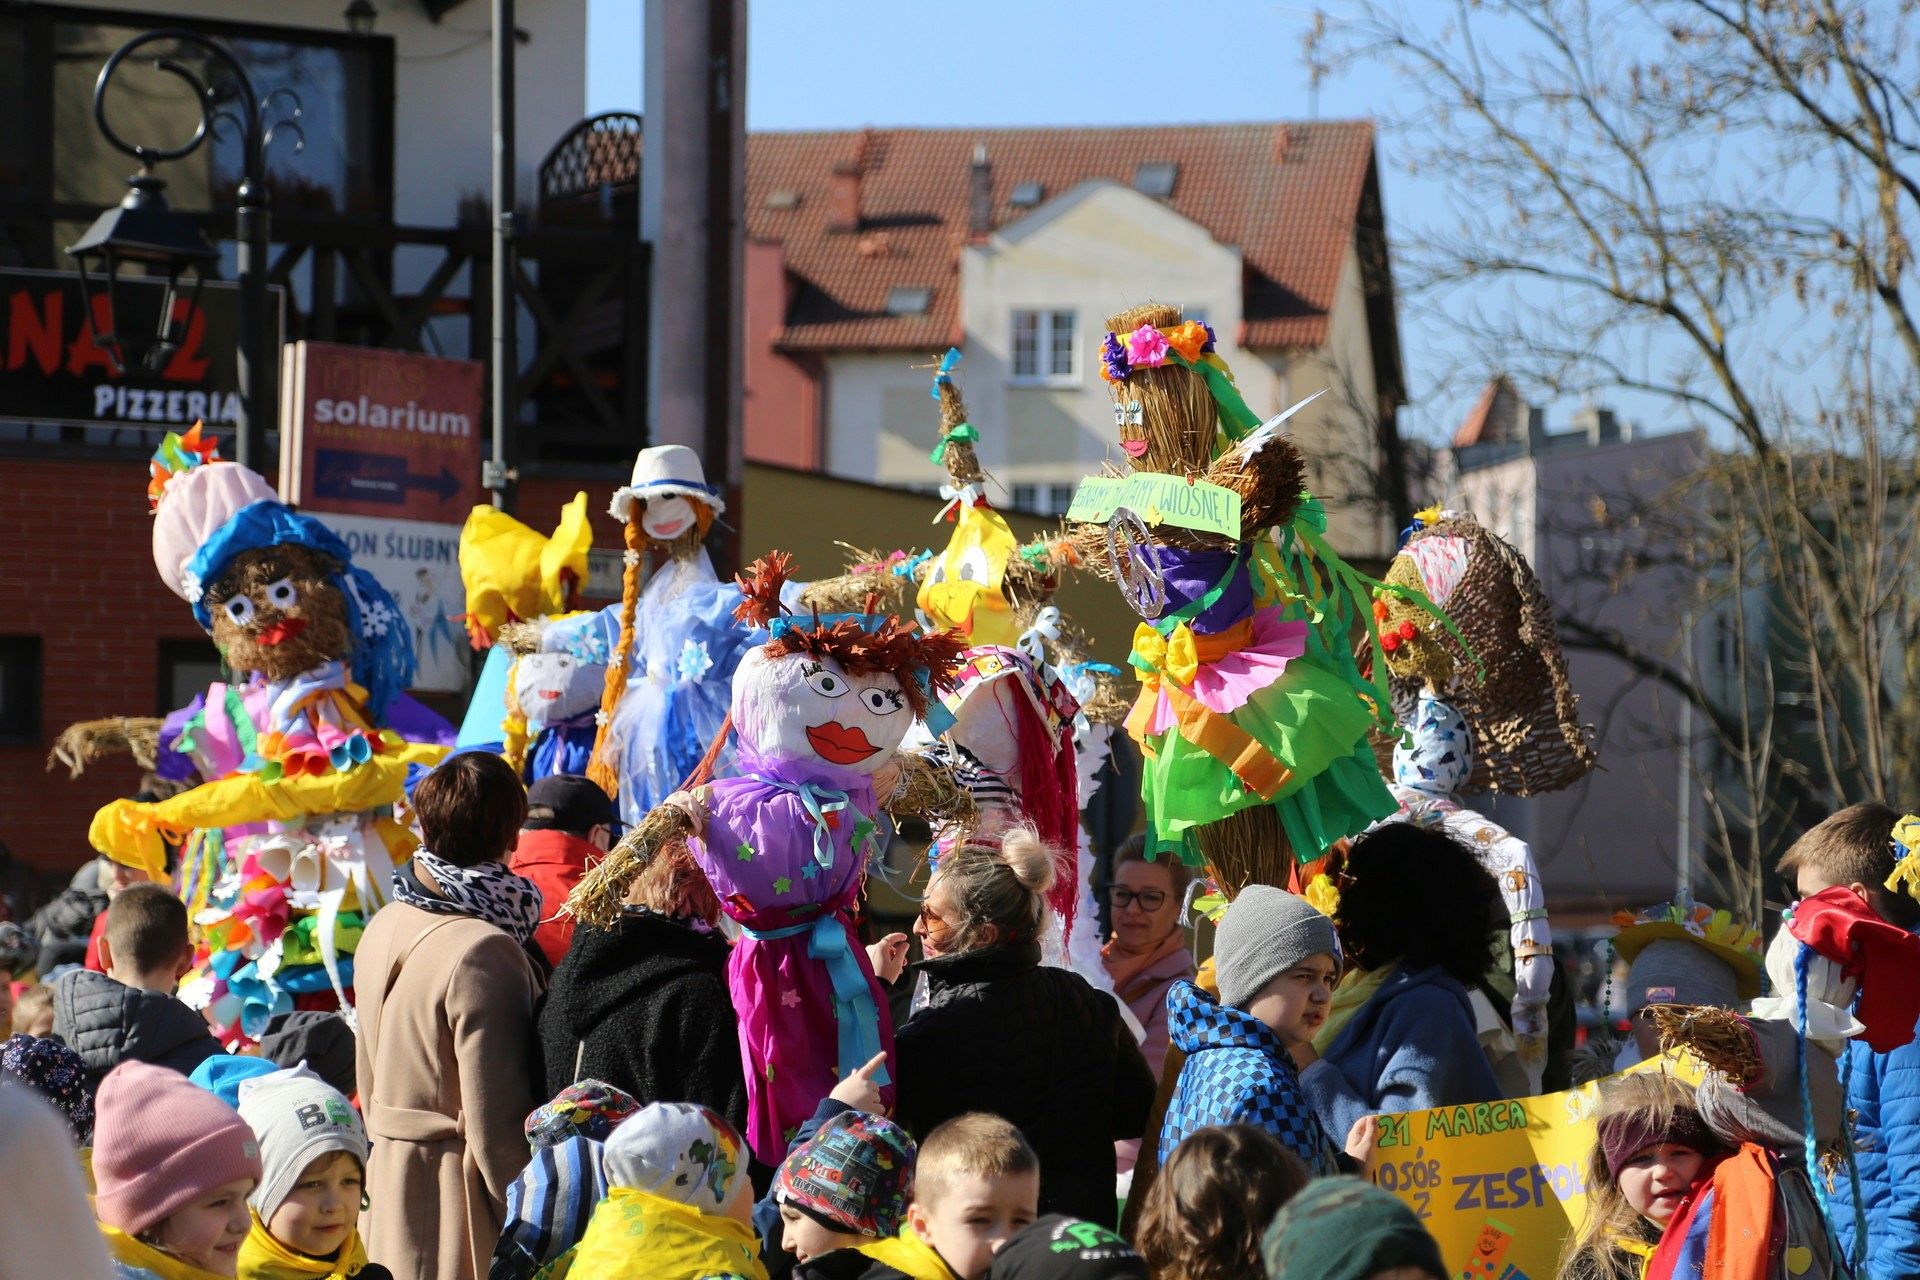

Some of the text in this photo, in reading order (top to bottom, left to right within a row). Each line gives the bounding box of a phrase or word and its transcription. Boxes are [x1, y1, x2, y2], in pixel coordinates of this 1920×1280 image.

[0, 288, 124, 378] NA
[94, 384, 242, 423] PIZZERIA
[314, 395, 471, 436] solarium
[1377, 1100, 1528, 1148] 21 MARCA
[1379, 1146, 1441, 1192] OSÓB
[1452, 1160, 1587, 1211] ZESPOŁ
